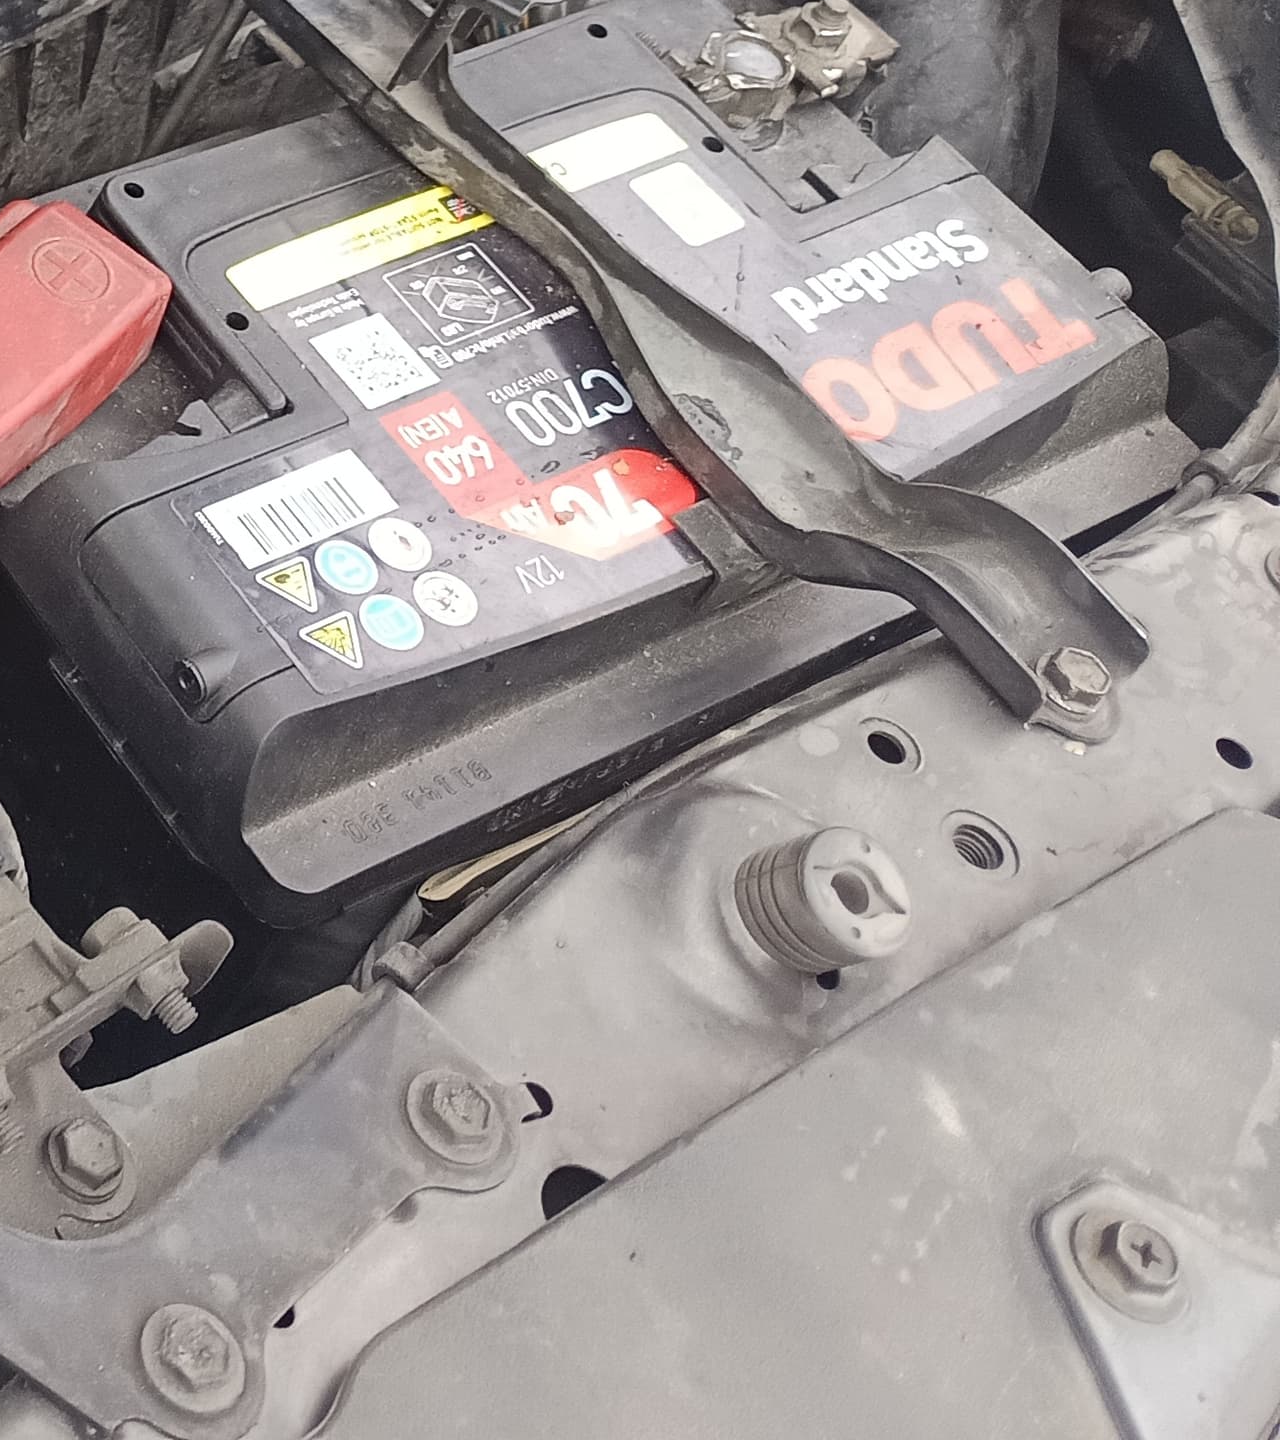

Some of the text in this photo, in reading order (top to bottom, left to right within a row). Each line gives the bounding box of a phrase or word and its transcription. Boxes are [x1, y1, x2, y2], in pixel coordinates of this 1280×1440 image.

[770, 218, 989, 335] Standard
[486, 368, 559, 404] DIN:57012
[801, 277, 1098, 442] TUDO
[505, 361, 634, 447] C700
[423, 434, 495, 486] 640
[514, 554, 566, 594] 12V
